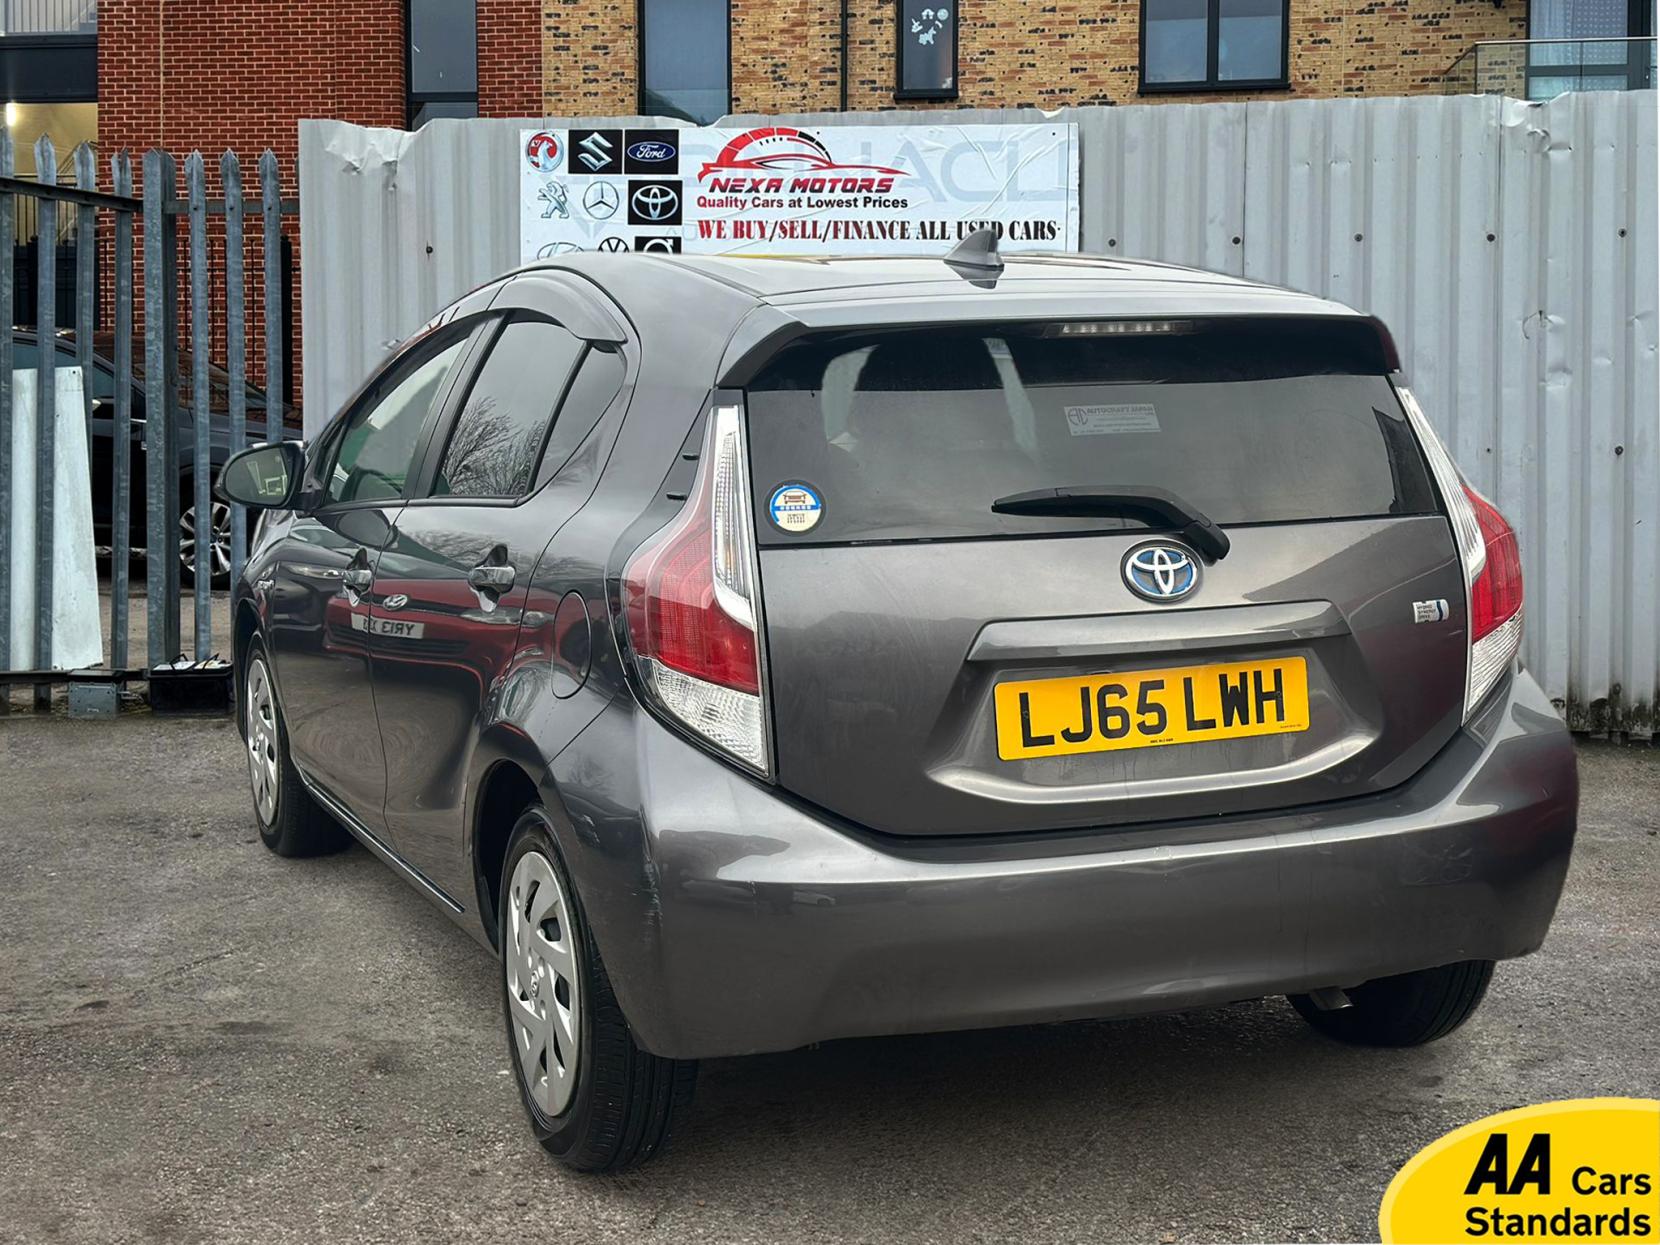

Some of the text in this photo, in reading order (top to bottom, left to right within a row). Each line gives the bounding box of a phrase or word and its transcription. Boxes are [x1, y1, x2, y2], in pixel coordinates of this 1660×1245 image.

[637, 144, 667, 159] Ford
[709, 178, 895, 193] NEXA MOTORS
[697, 196, 909, 210] Quality Cars at Lowest Prices
[698, 220, 727, 240] WE
[733, 220, 911, 242] BUY/SELL/FINANCE
[916, 221, 951, 241] ALL
[1018, 668, 1286, 748] LJ65 LWH
